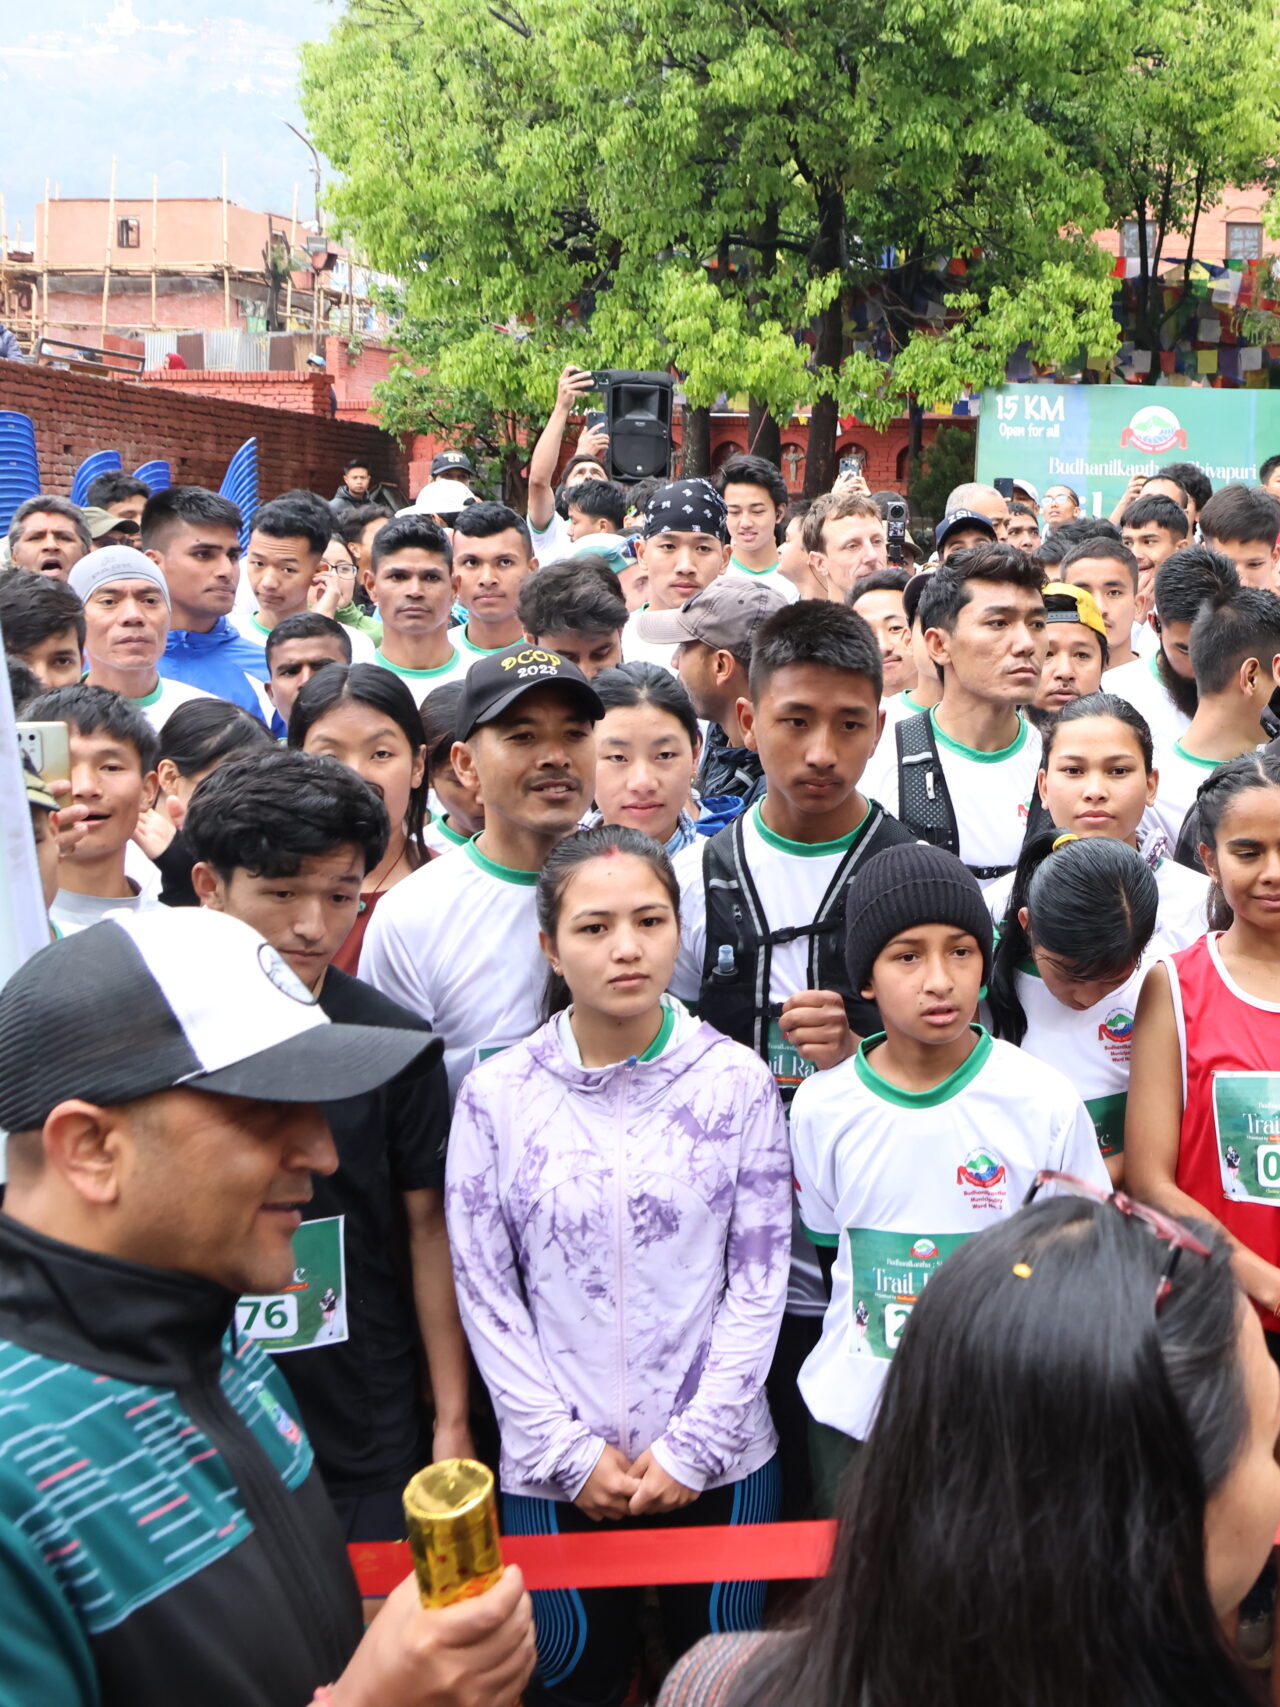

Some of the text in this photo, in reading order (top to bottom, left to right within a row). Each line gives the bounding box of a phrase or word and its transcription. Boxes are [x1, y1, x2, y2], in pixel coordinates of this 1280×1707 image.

[996, 395, 1065, 421] 15 KM
[999, 423, 1060, 439] Open for all
[517, 664, 558, 678] 2023
[873, 1267, 914, 1295] Trail
[237, 1299, 288, 1331] 76
